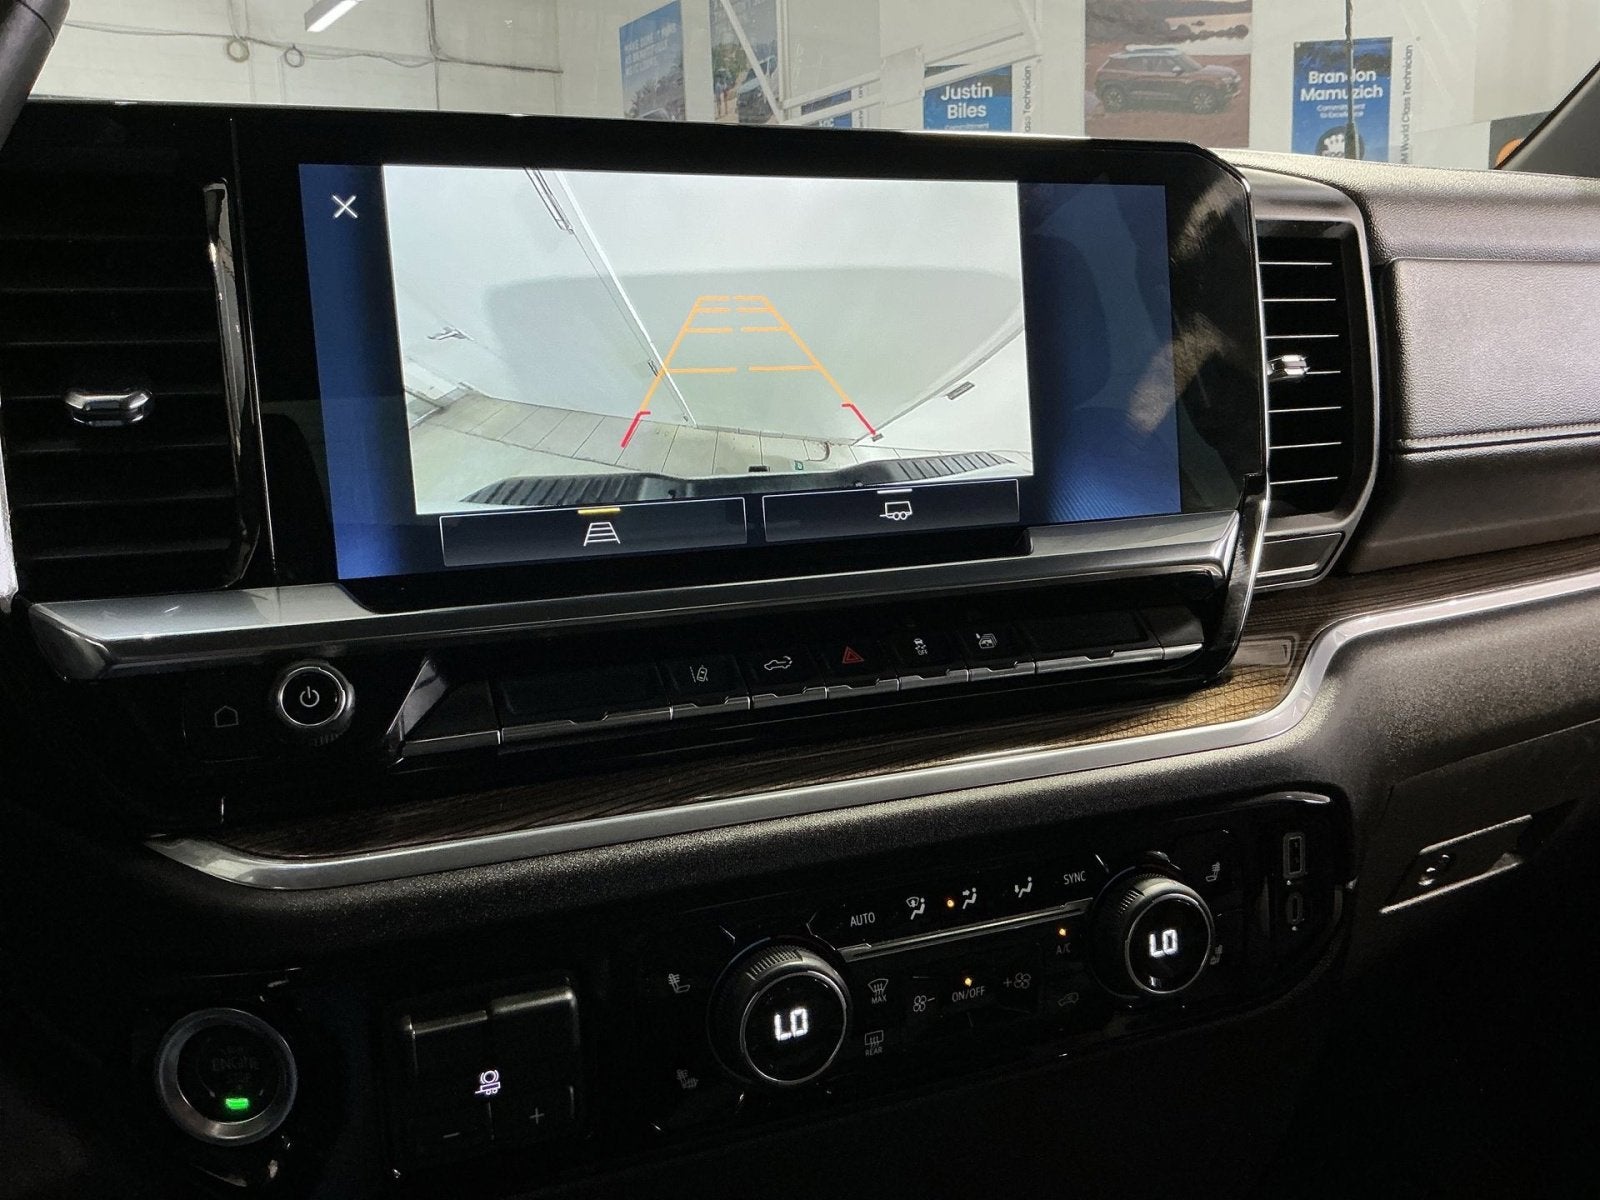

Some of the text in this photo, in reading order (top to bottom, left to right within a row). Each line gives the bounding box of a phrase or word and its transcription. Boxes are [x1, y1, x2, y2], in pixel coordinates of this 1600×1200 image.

[1403, 45, 1413, 95] Technician
[940, 82, 993, 101] Justin
[1022, 65, 1032, 114] Technician
[947, 102, 987, 119] Biles
[1401, 97, 1411, 123] Class
[1063, 870, 1087, 886] SYNC
[850, 911, 876, 927] AUTO
[1056, 942, 1072, 957] A/C
[1148, 929, 1179, 959] LO
[871, 994, 888, 1005] MAX
[951, 985, 987, 1003] ON/OFF
[773, 1006, 809, 1042] LO
[865, 1046, 884, 1057] REAR
